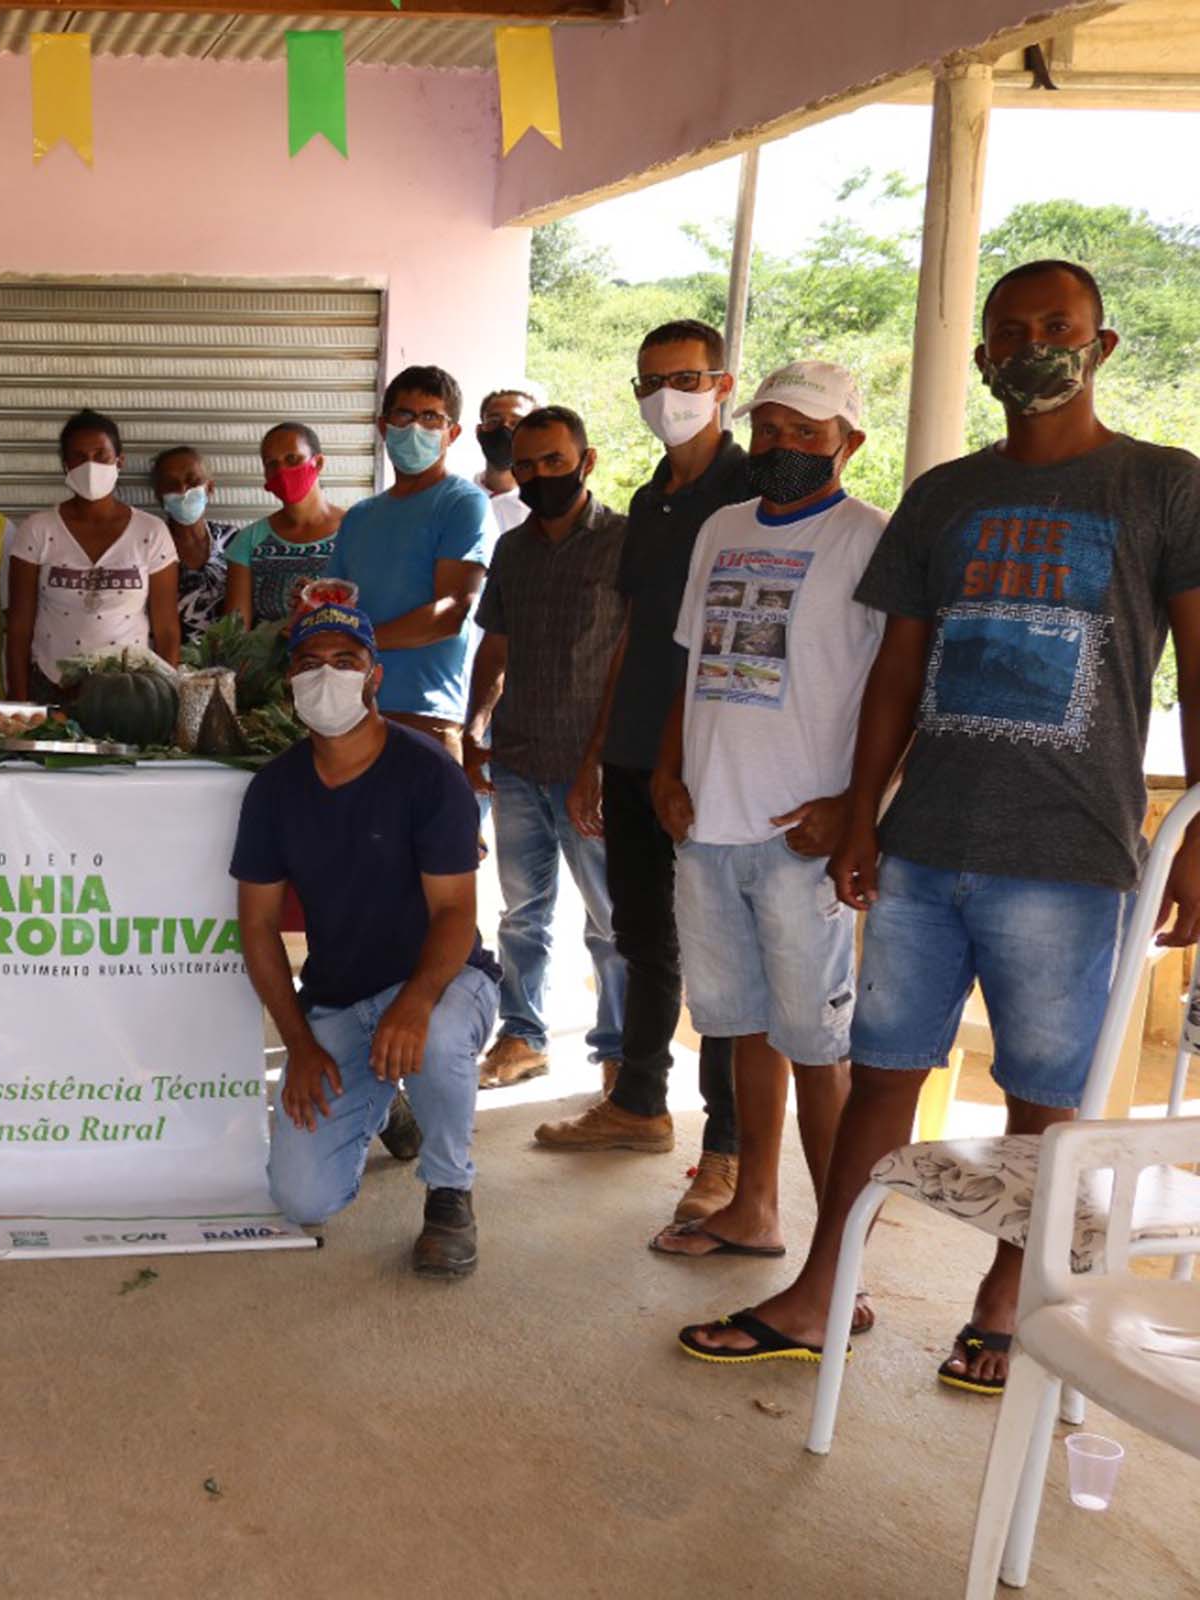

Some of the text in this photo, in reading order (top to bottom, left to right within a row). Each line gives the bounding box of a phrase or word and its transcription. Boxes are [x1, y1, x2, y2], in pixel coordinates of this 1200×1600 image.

[977, 517, 1073, 555] FREE
[99, 963, 143, 977] RURAL
[151, 1072, 261, 1102] Técnica
[79, 1115, 166, 1142] Rural
